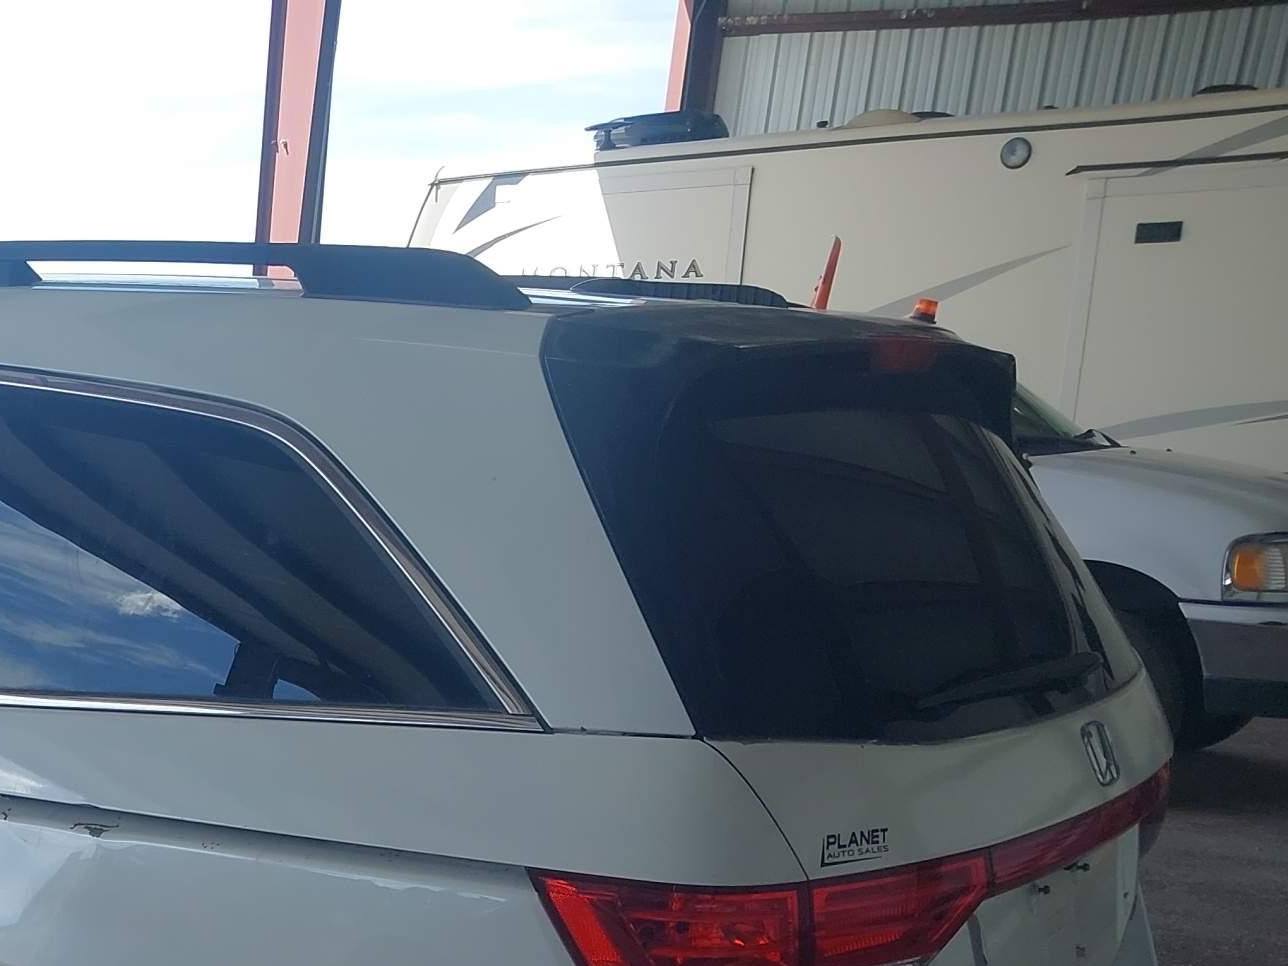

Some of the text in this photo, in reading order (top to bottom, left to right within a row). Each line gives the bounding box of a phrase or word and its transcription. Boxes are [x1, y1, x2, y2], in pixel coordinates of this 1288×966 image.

[825, 827, 889, 850] PLANET
[826, 844, 889, 860] AUTO SALES
